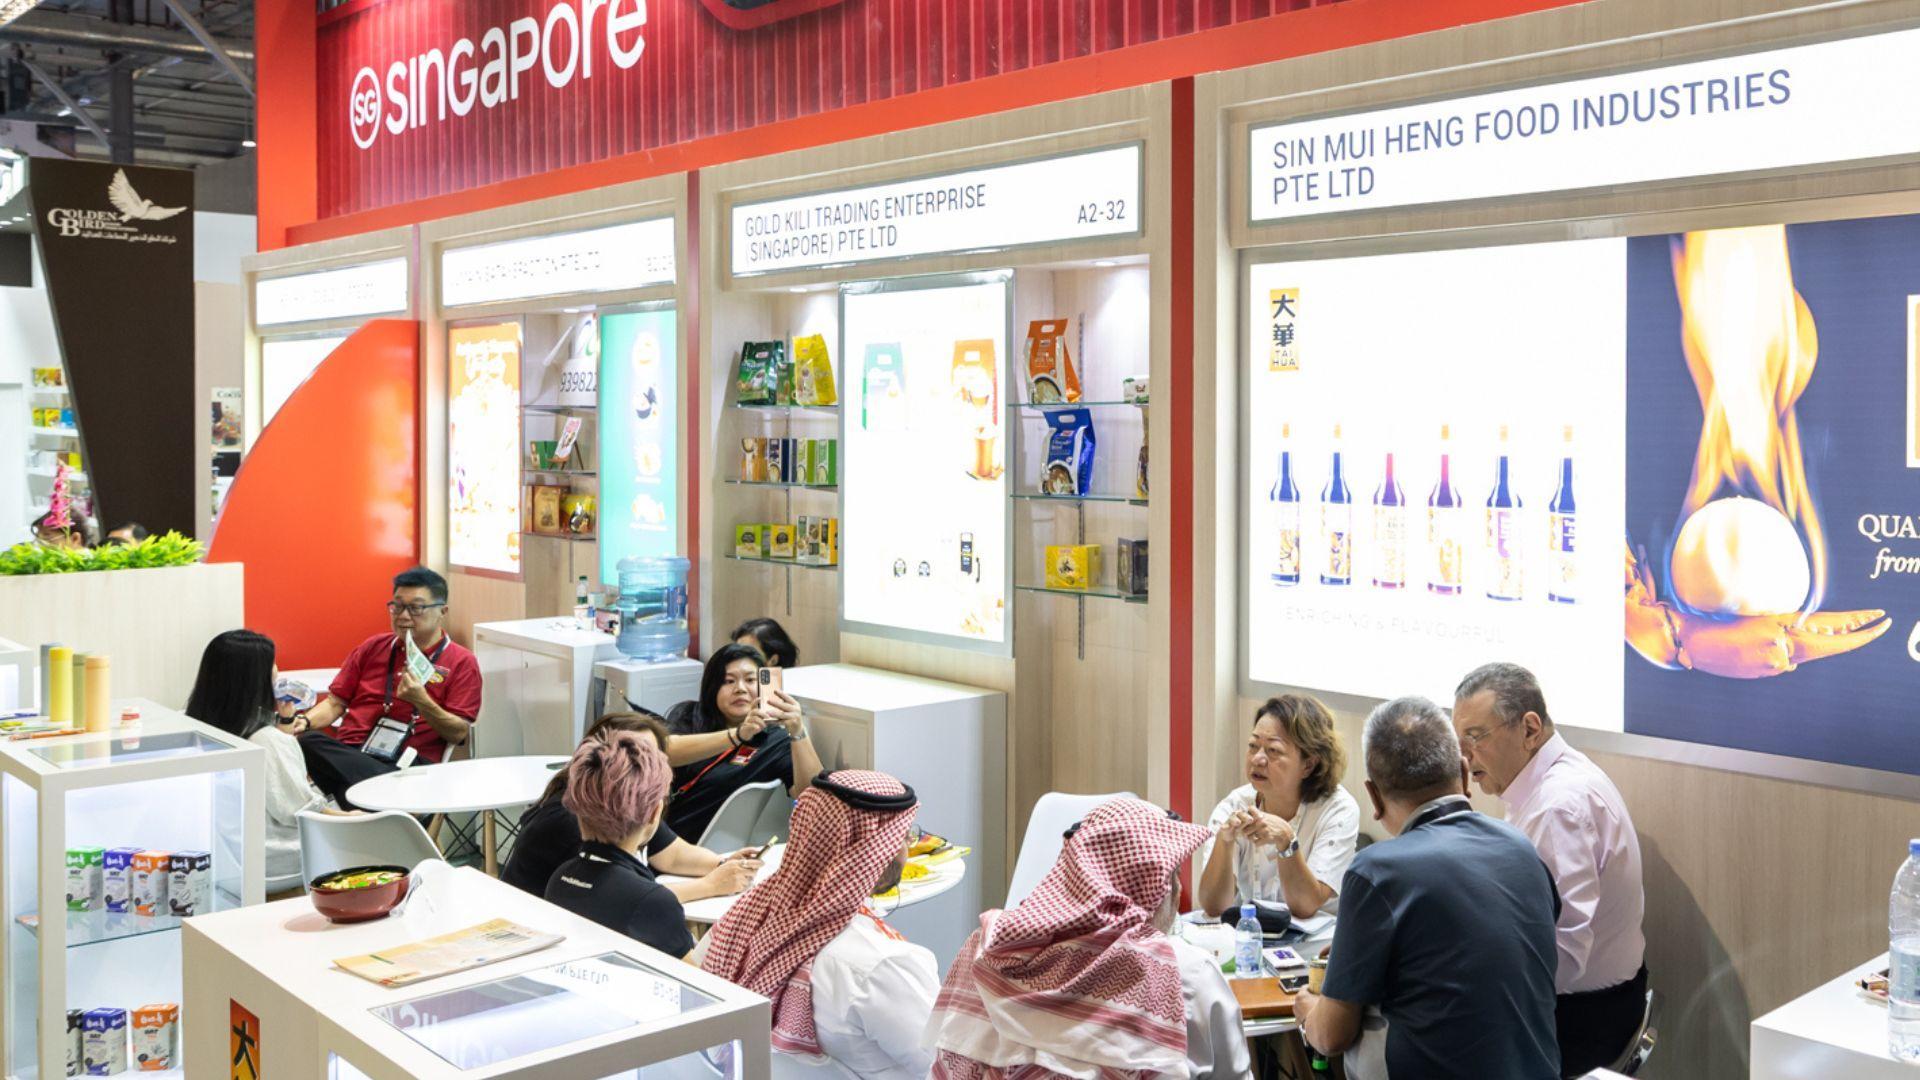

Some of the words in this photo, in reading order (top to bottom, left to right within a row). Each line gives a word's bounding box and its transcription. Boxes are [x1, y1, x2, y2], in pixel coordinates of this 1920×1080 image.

[354, 89, 377, 126] SG
[1273, 137, 1315, 169] SIN
[1325, 129, 1375, 162] MUI
[1385, 116, 1464, 156] HENG
[1476, 102, 1560, 144] FOOD
[1573, 68, 1792, 131] INDUSTRIES
[1273, 172, 1319, 205] PTE
[1328, 167, 1375, 198] LTD
[47, 208, 117, 227] GOLDEN
[746, 213, 781, 237] GOLD
[785, 208, 811, 232] KILI
[814, 200, 880, 228] TRADING
[885, 184, 986, 220] ENTERPRISE
[1077, 199, 1126, 225] A2-32
[59, 217, 105, 237] BIRD
[838, 228, 866, 251] PTE
[870, 224, 898, 248] LTD
[1272, 294, 1296, 347] 大華
[1272, 358, 1296, 367] HUA
[1858, 513, 1920, 542] QUA
